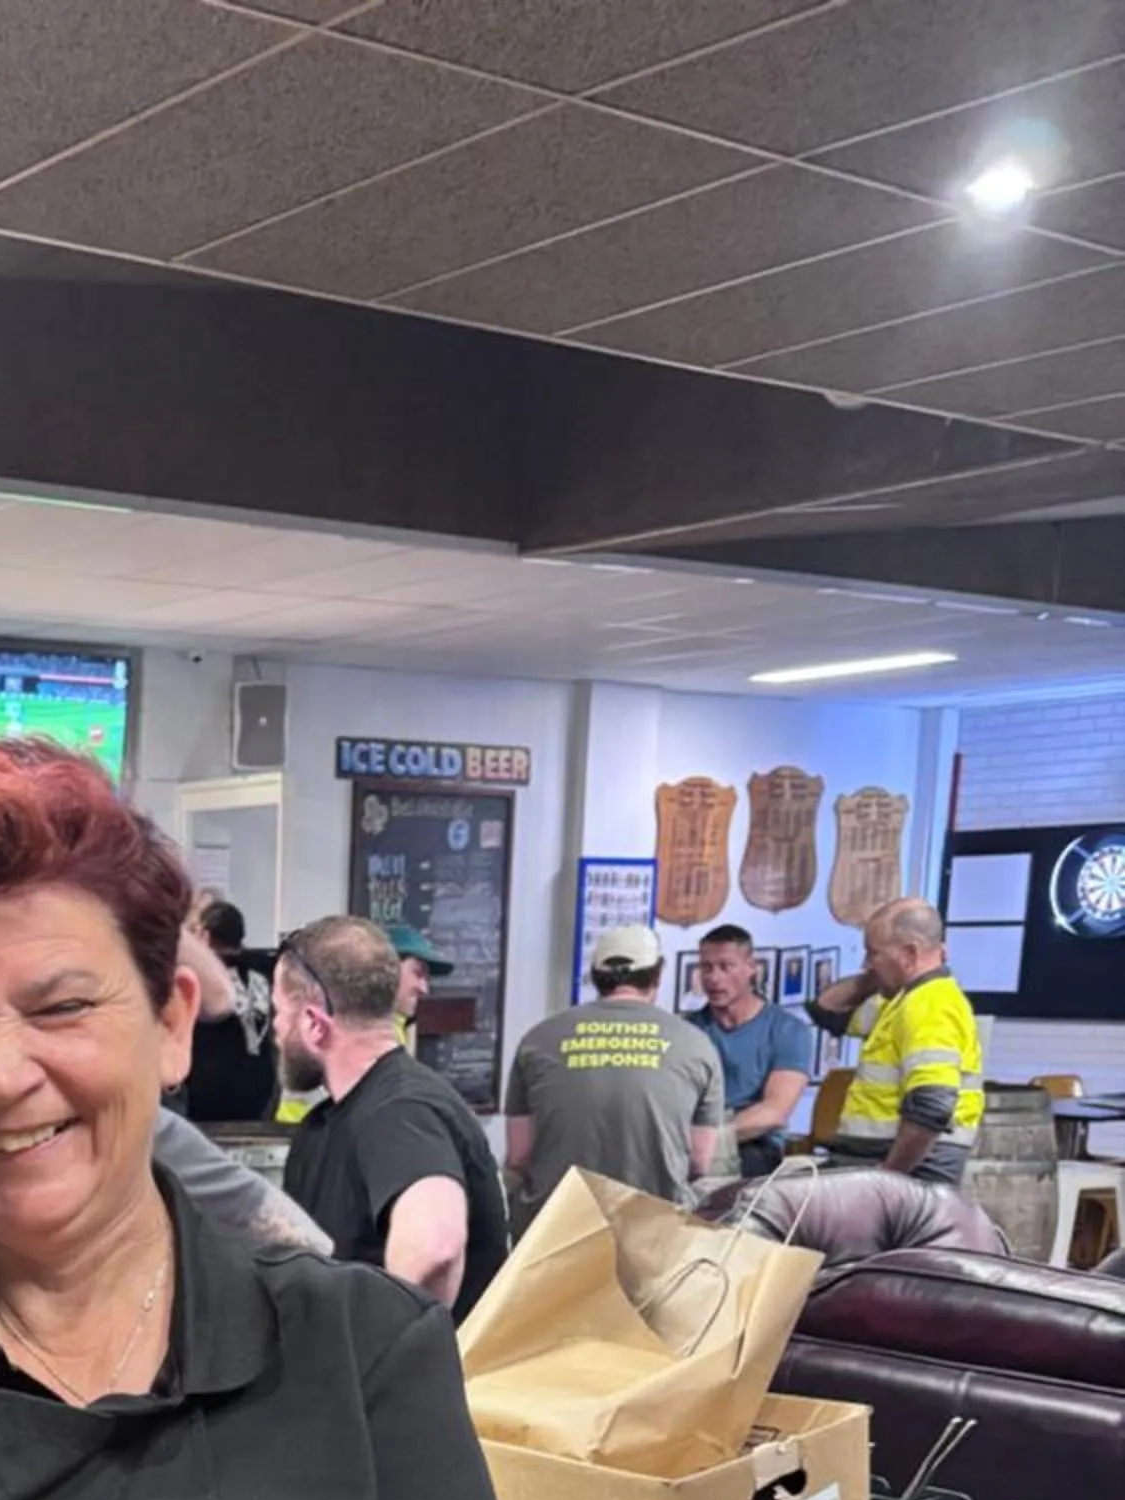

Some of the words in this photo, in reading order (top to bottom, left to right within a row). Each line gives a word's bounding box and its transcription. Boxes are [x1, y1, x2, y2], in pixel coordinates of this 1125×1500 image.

[340, 739, 387, 773] ICE
[388, 744, 463, 776] COLD
[465, 746, 530, 781] BEER
[560, 1036, 672, 1053] EMERGENCY
[567, 1052, 661, 1070] RESPONSE
